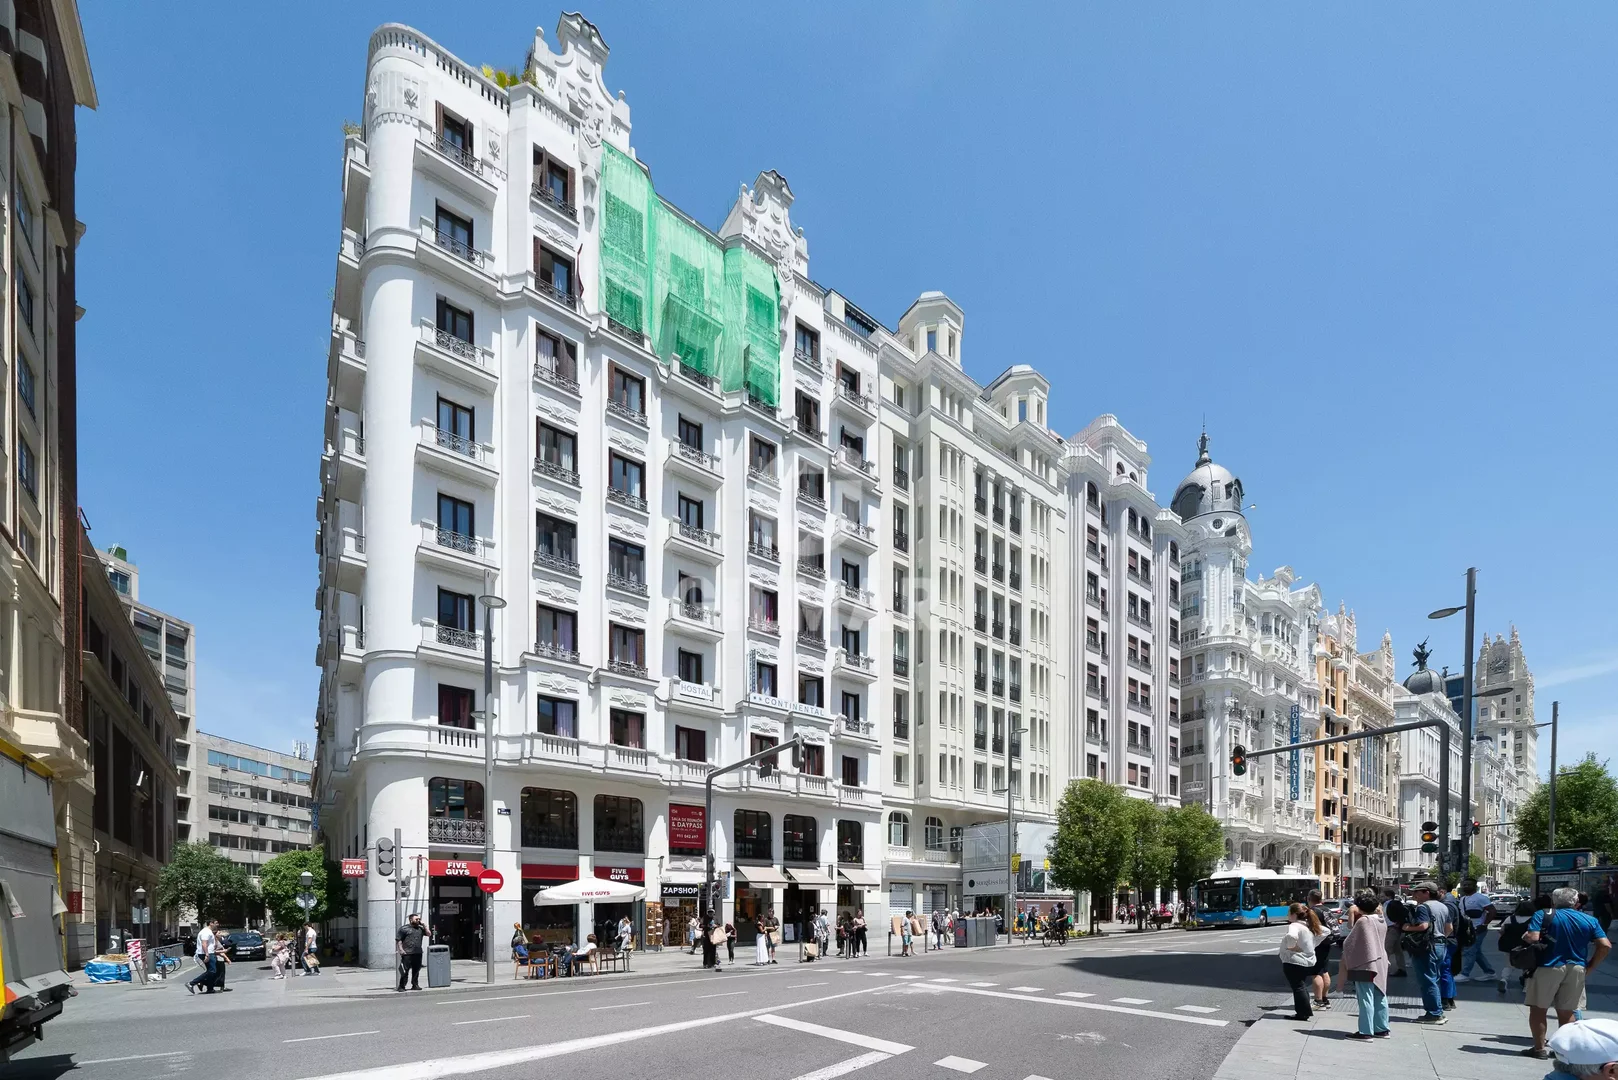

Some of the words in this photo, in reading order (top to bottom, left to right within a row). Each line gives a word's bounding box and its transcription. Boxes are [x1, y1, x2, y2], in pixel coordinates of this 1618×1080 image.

[681, 683, 711, 697] HOSTAL
[764, 696, 825, 717] CONTINENTAL
[447, 861, 467, 869] FIVE
[445, 868, 470, 876] GUYS
[662, 886, 698, 894] ZAPSHOP
